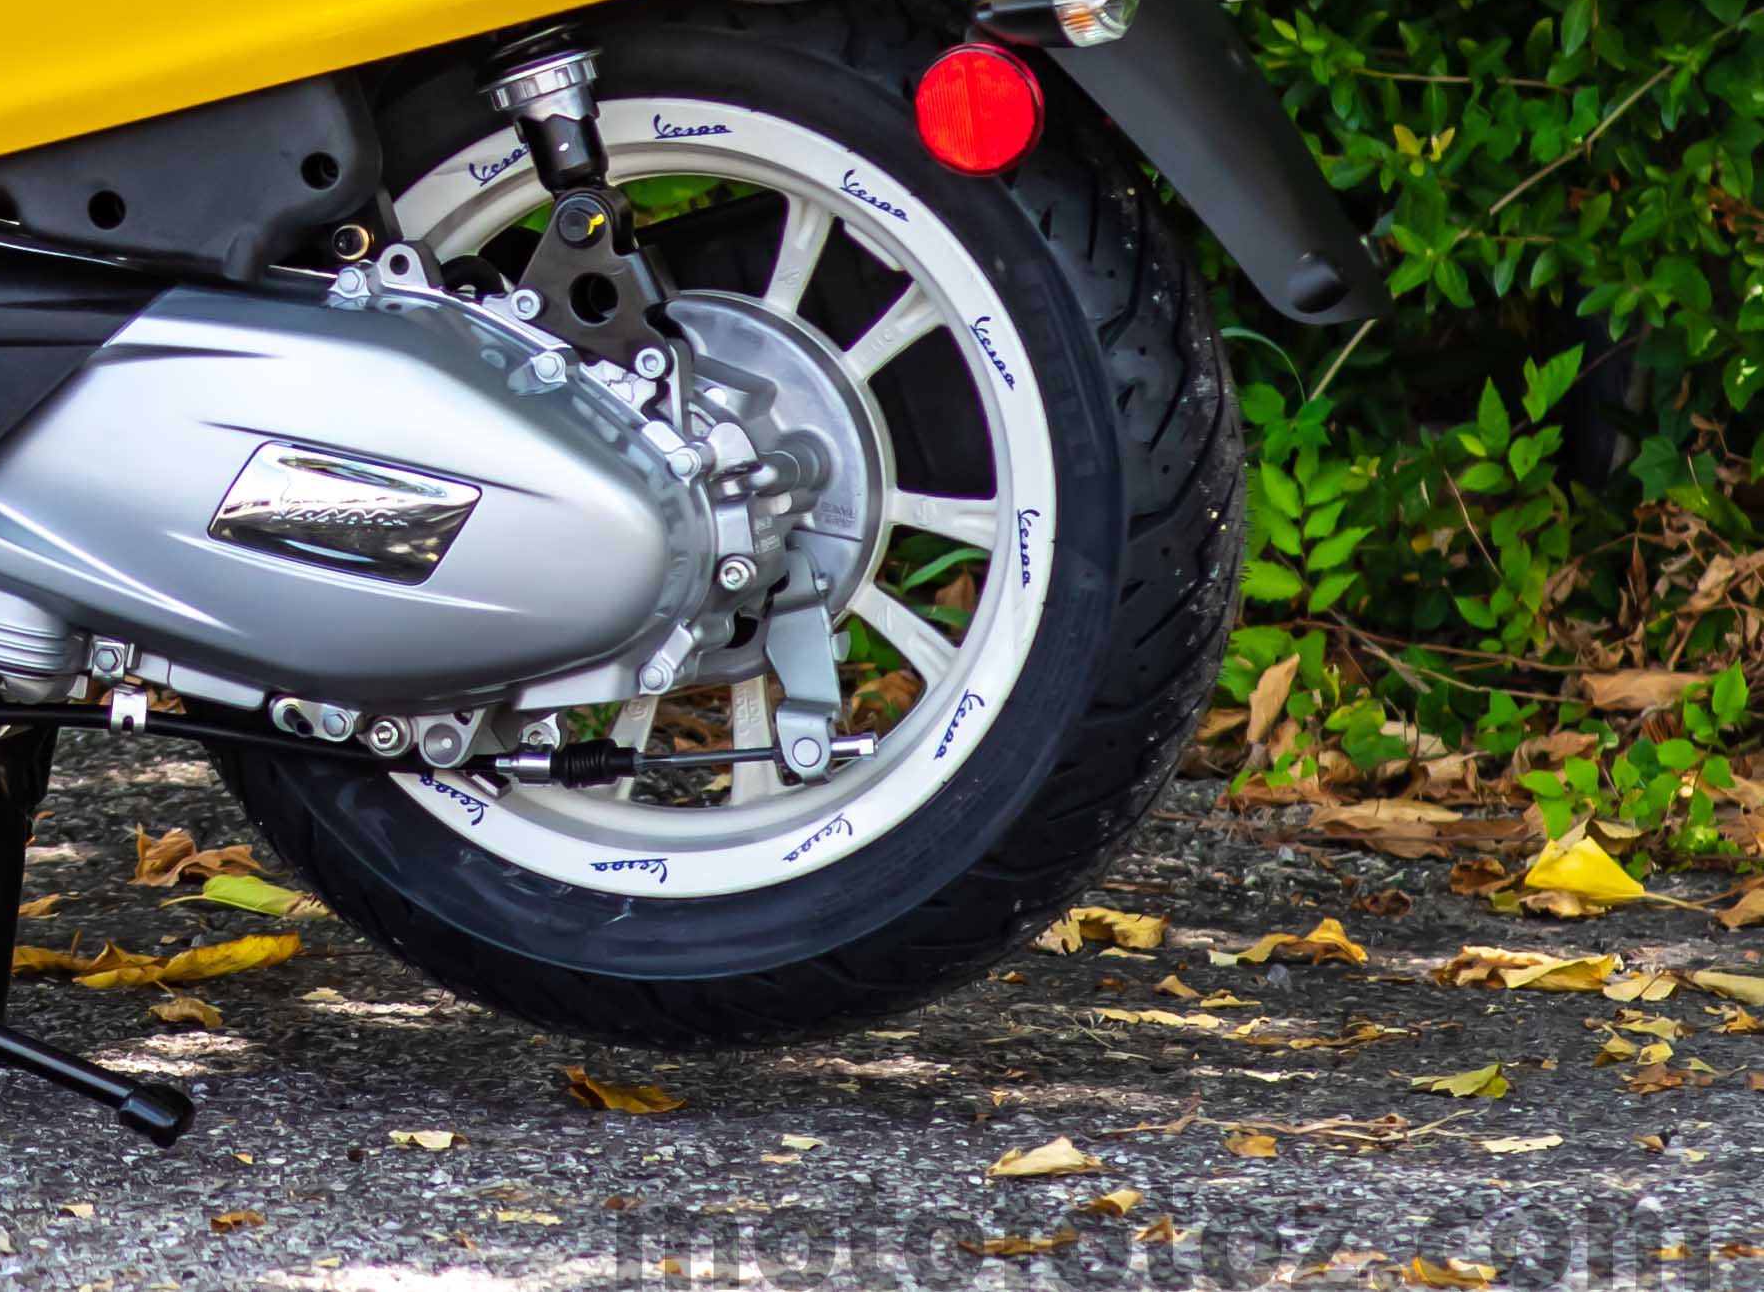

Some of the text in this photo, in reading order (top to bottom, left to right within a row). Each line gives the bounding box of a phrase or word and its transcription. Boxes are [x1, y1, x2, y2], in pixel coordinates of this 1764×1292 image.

[654, 114, 733, 139] Vespa
[469, 144, 529, 187] Vesp
[841, 170, 909, 222] Vespa
[970, 316, 1015, 391] Vespa
[1017, 508, 1041, 589] Vespa
[934, 689, 986, 760] Vespa
[420, 772, 489, 826] Vespa
[782, 813, 853, 863] Vespa
[589, 857, 669, 884] Vespa
